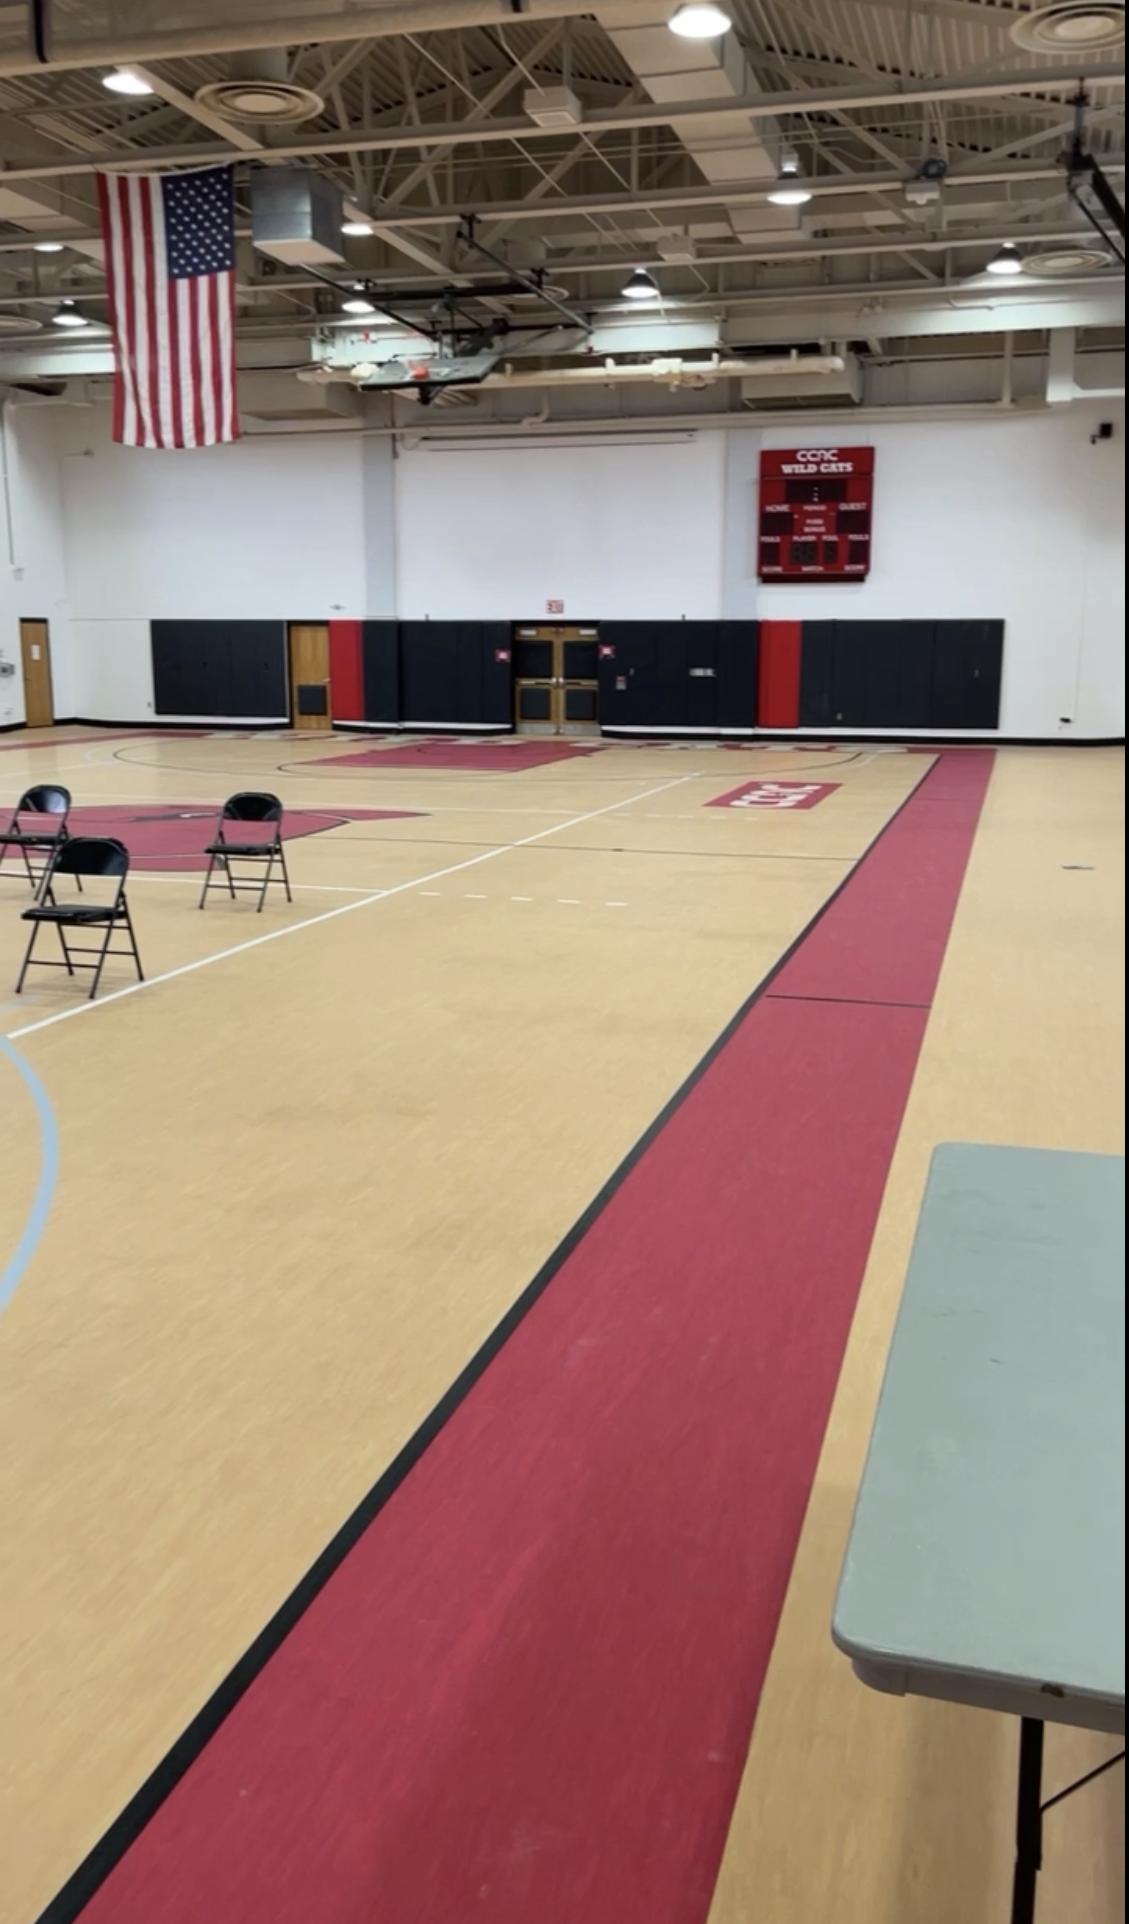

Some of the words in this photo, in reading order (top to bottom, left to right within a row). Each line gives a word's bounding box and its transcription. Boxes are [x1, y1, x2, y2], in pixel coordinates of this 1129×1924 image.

[781, 464, 818, 474] WILD
[820, 462, 853, 473] CATS
[838, 503, 867, 511] GUEST
